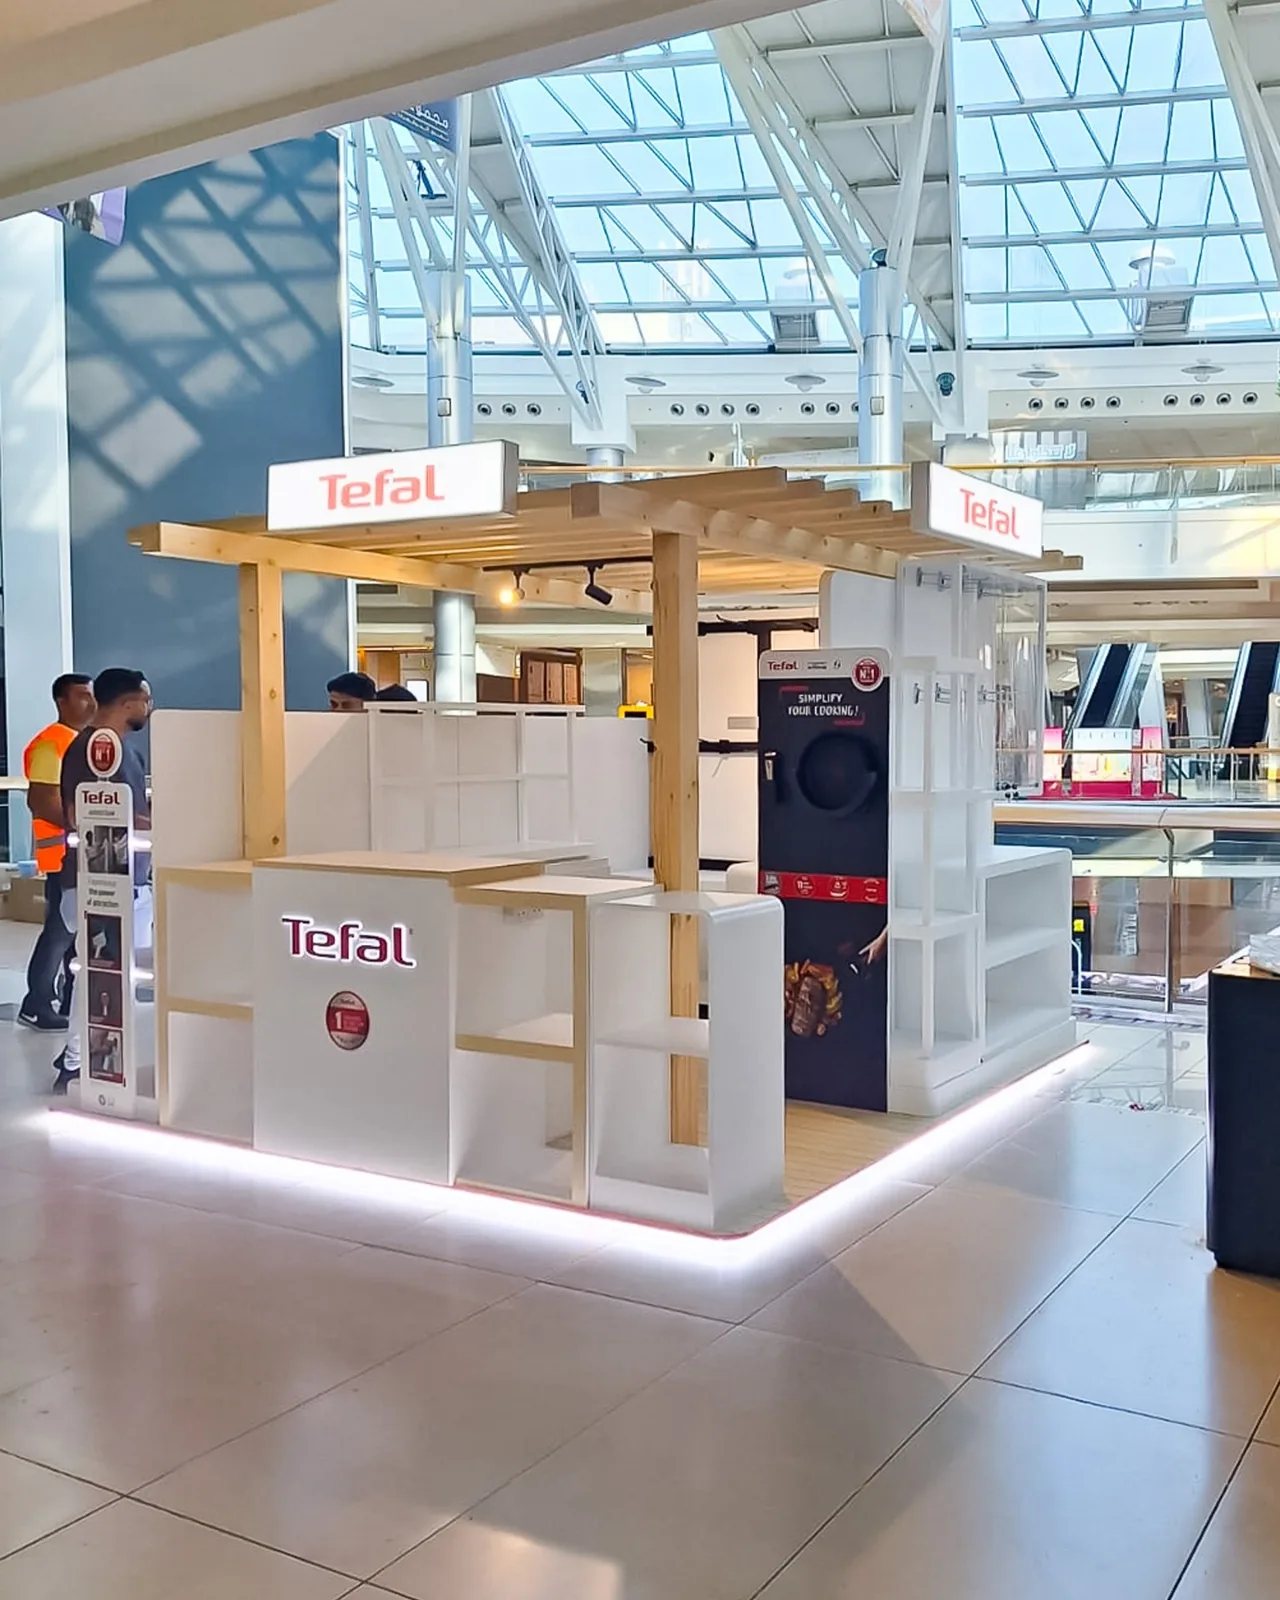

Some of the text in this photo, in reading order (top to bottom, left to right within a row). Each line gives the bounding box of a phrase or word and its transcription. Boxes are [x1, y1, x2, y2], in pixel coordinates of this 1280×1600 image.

[319, 464, 445, 510] Tefal
[959, 487, 1020, 540] Tefal
[767, 661, 799, 671] Tefal
[798, 693, 843, 703] SIMPLIFY
[787, 705, 812, 716] YOUR
[82, 789, 121, 806] Tefal
[281, 917, 414, 967] Tefal
